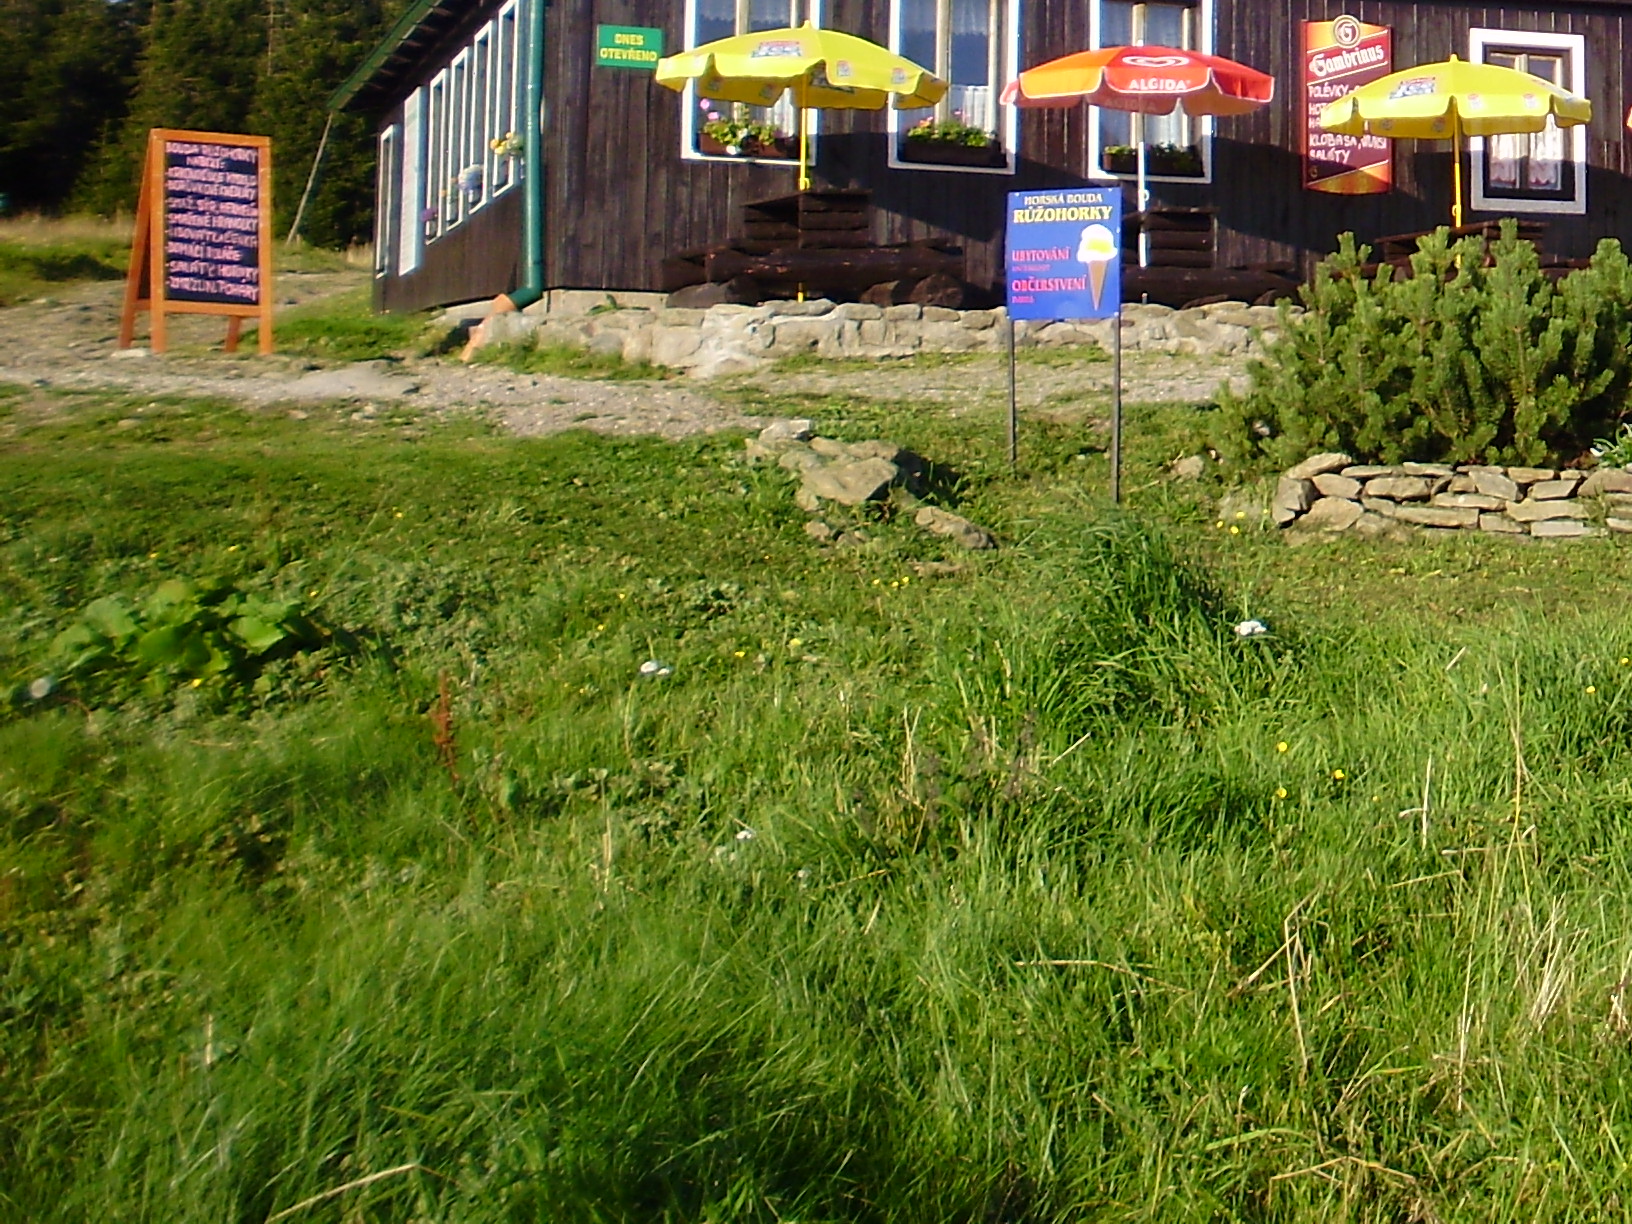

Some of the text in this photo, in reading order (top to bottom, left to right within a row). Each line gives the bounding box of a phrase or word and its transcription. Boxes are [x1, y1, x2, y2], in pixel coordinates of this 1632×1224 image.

[614, 34, 645, 45] DNES
[600, 46, 657, 62] OTEVŘENO
[1309, 44, 1385, 77] Gambrinus
[1129, 79, 1187, 90] ALGIDA
[1024, 192, 1102, 205] HORSKÁ BOUDA
[1013, 205, 1112, 223] RŮŽOHORKY
[1012, 247, 1070, 262] UBYTOVÁNÍ
[1012, 275, 1087, 292] OBČERSTVENÍ
